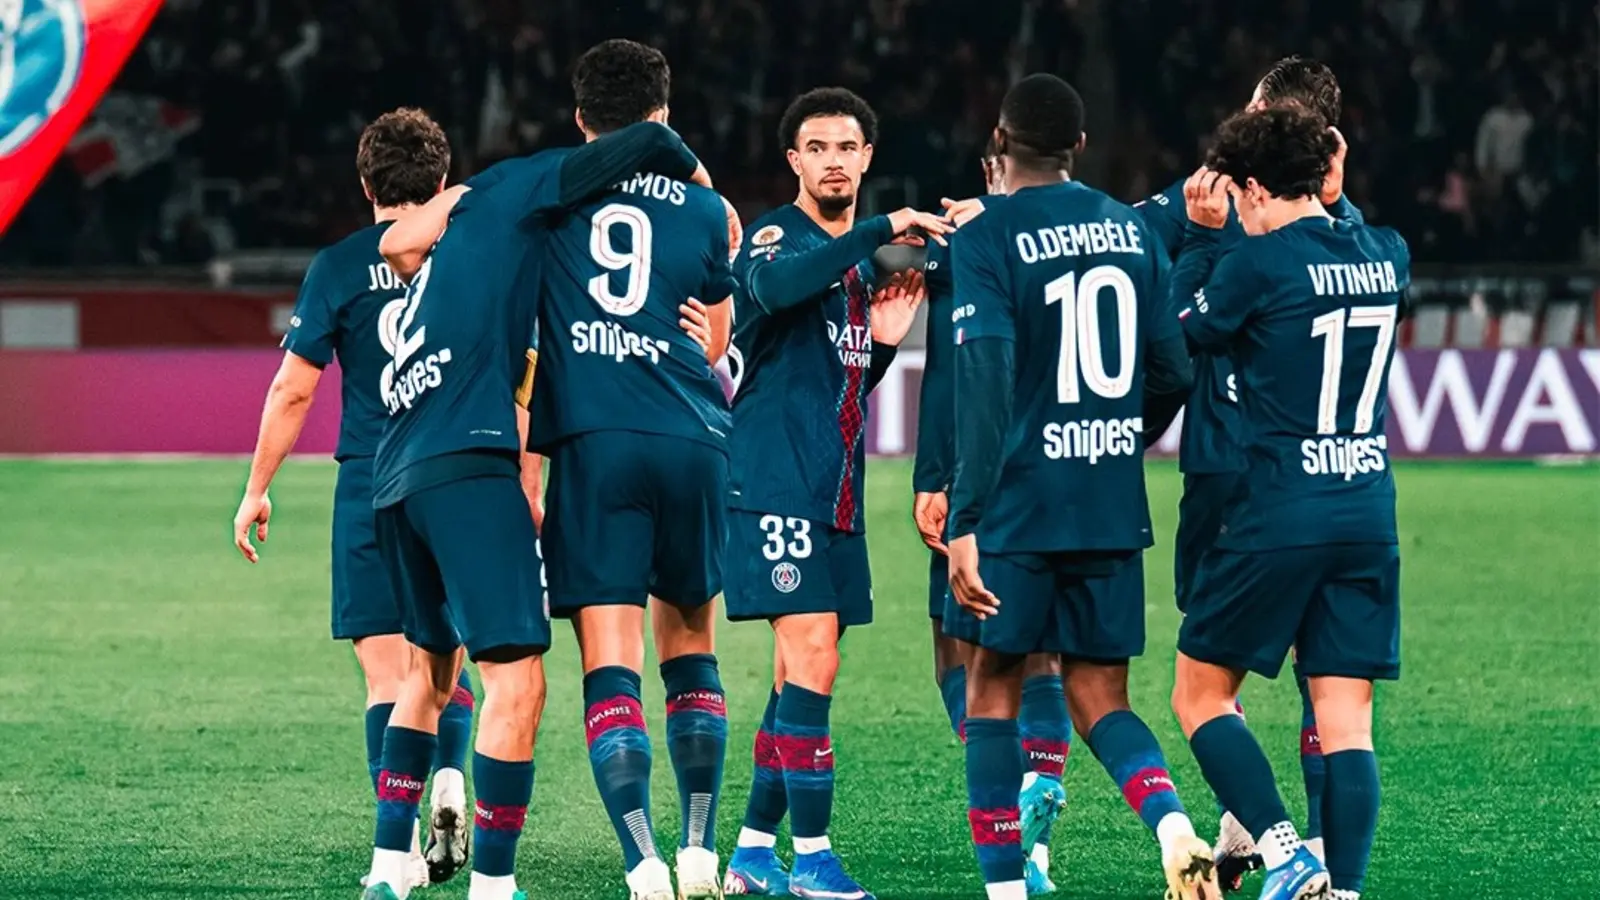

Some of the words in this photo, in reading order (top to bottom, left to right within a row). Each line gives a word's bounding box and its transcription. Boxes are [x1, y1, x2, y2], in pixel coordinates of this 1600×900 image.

[587, 203, 653, 317] 9
[1306, 260, 1399, 296] VITINHA
[1044, 264, 1138, 404] 10
[1309, 303, 1398, 436] 17
[1042, 418, 1137, 466] snipes
[759, 513, 813, 561] 33
[1029, 750, 1066, 764] PARIS
